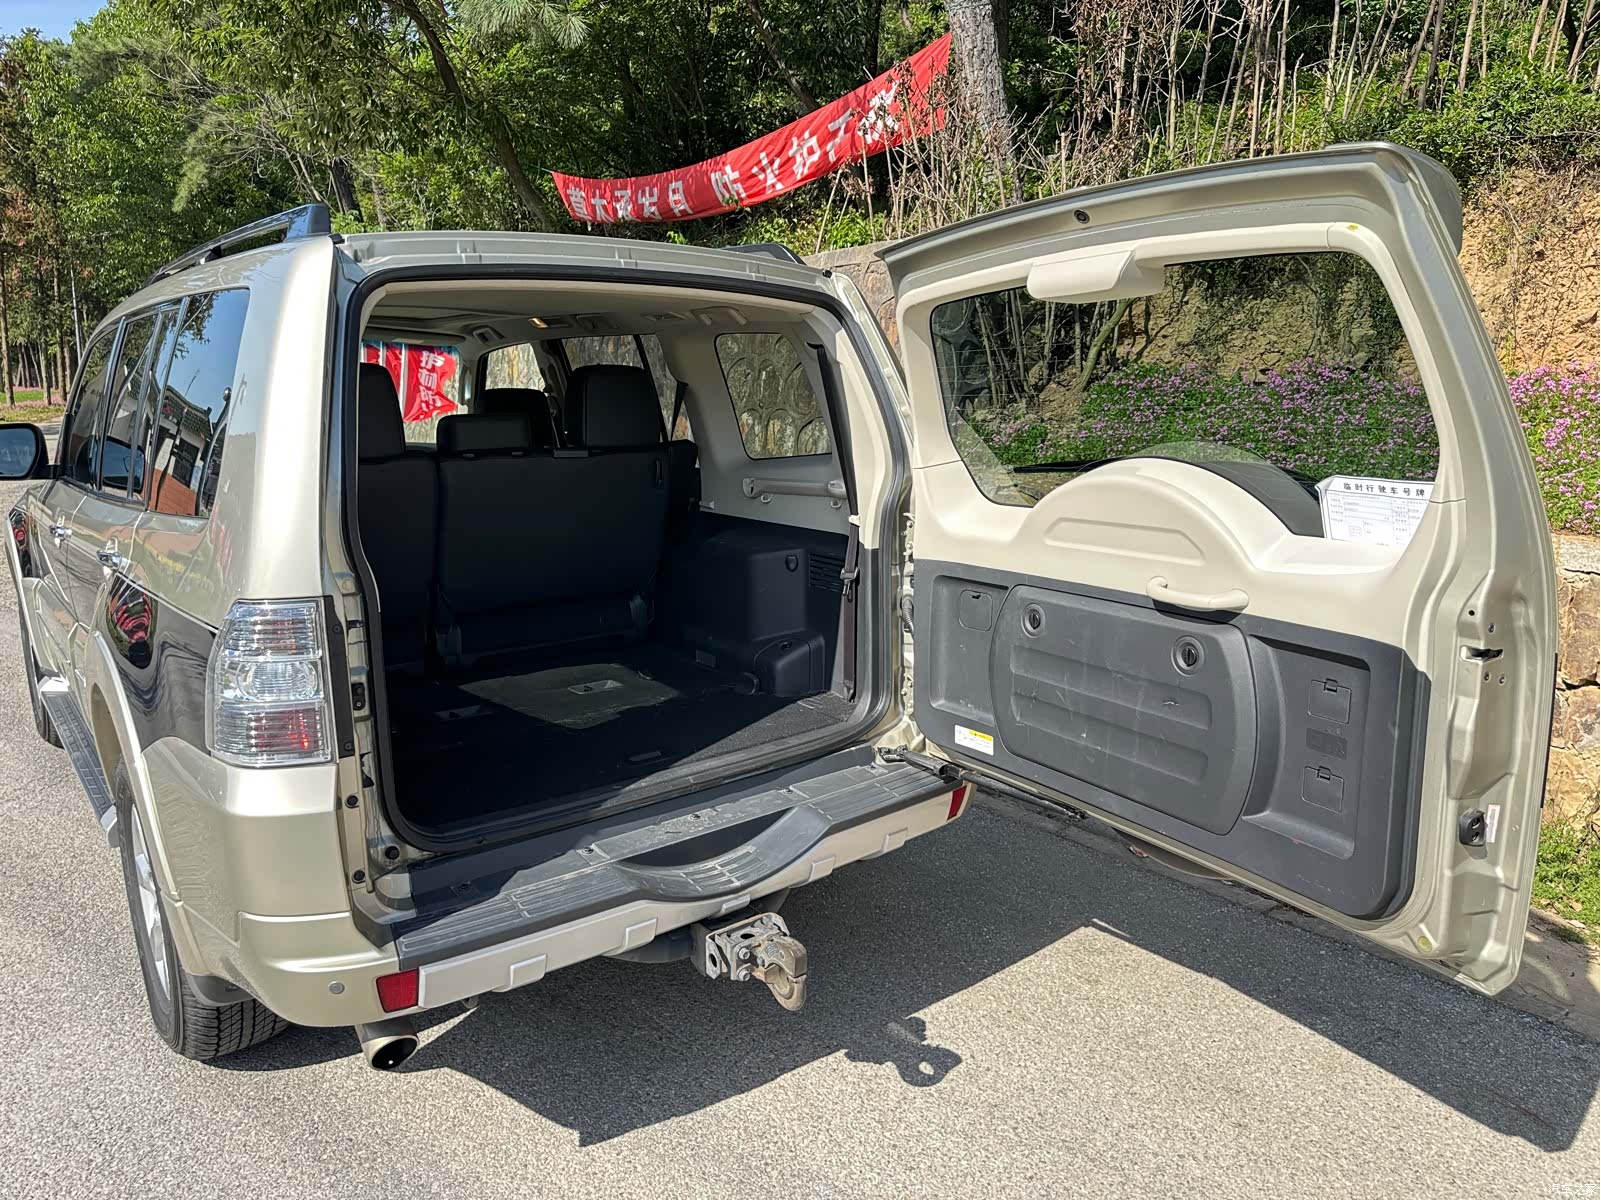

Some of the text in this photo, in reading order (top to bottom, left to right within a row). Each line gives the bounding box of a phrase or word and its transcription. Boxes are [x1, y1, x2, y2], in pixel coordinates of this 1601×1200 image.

[1343, 482, 1425, 497] 临时行驶车号牌
